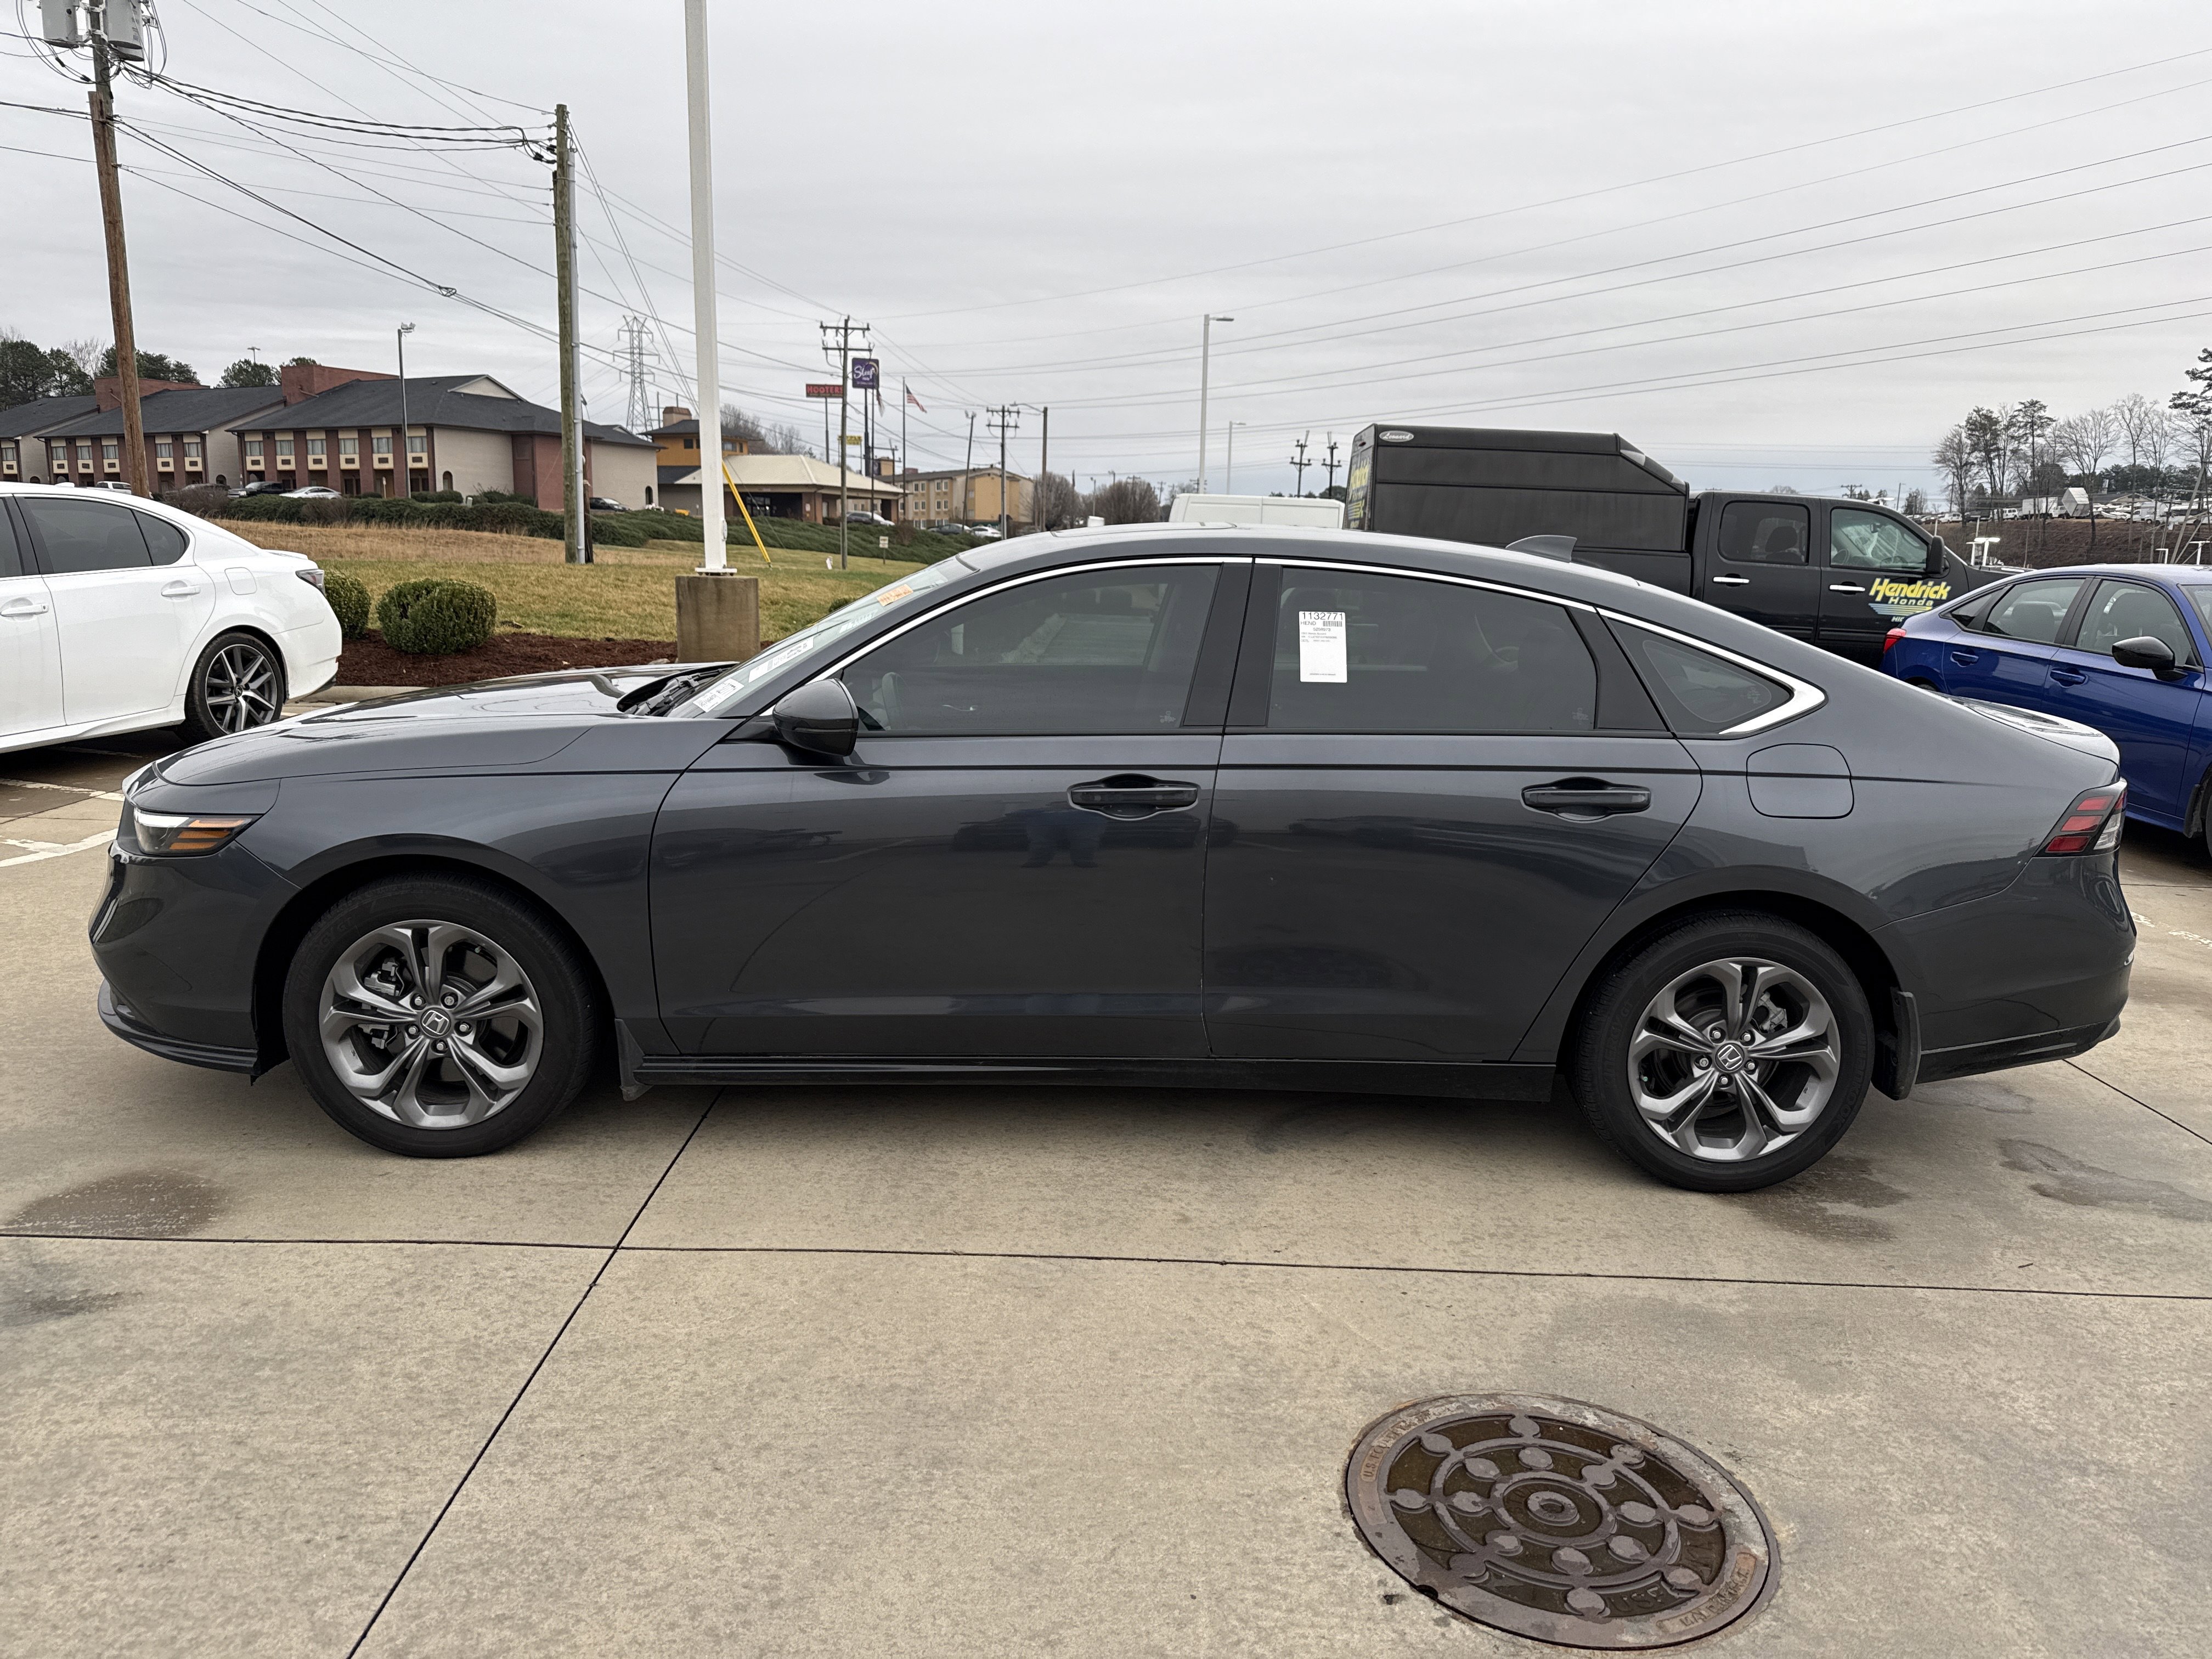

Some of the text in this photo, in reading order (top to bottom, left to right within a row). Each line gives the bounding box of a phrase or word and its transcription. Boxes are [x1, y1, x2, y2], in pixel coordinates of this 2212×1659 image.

[1869, 578, 1951, 601] Hendrick
[1888, 596, 1933, 606] Honda
[1302, 612, 1343, 620] 1132771
